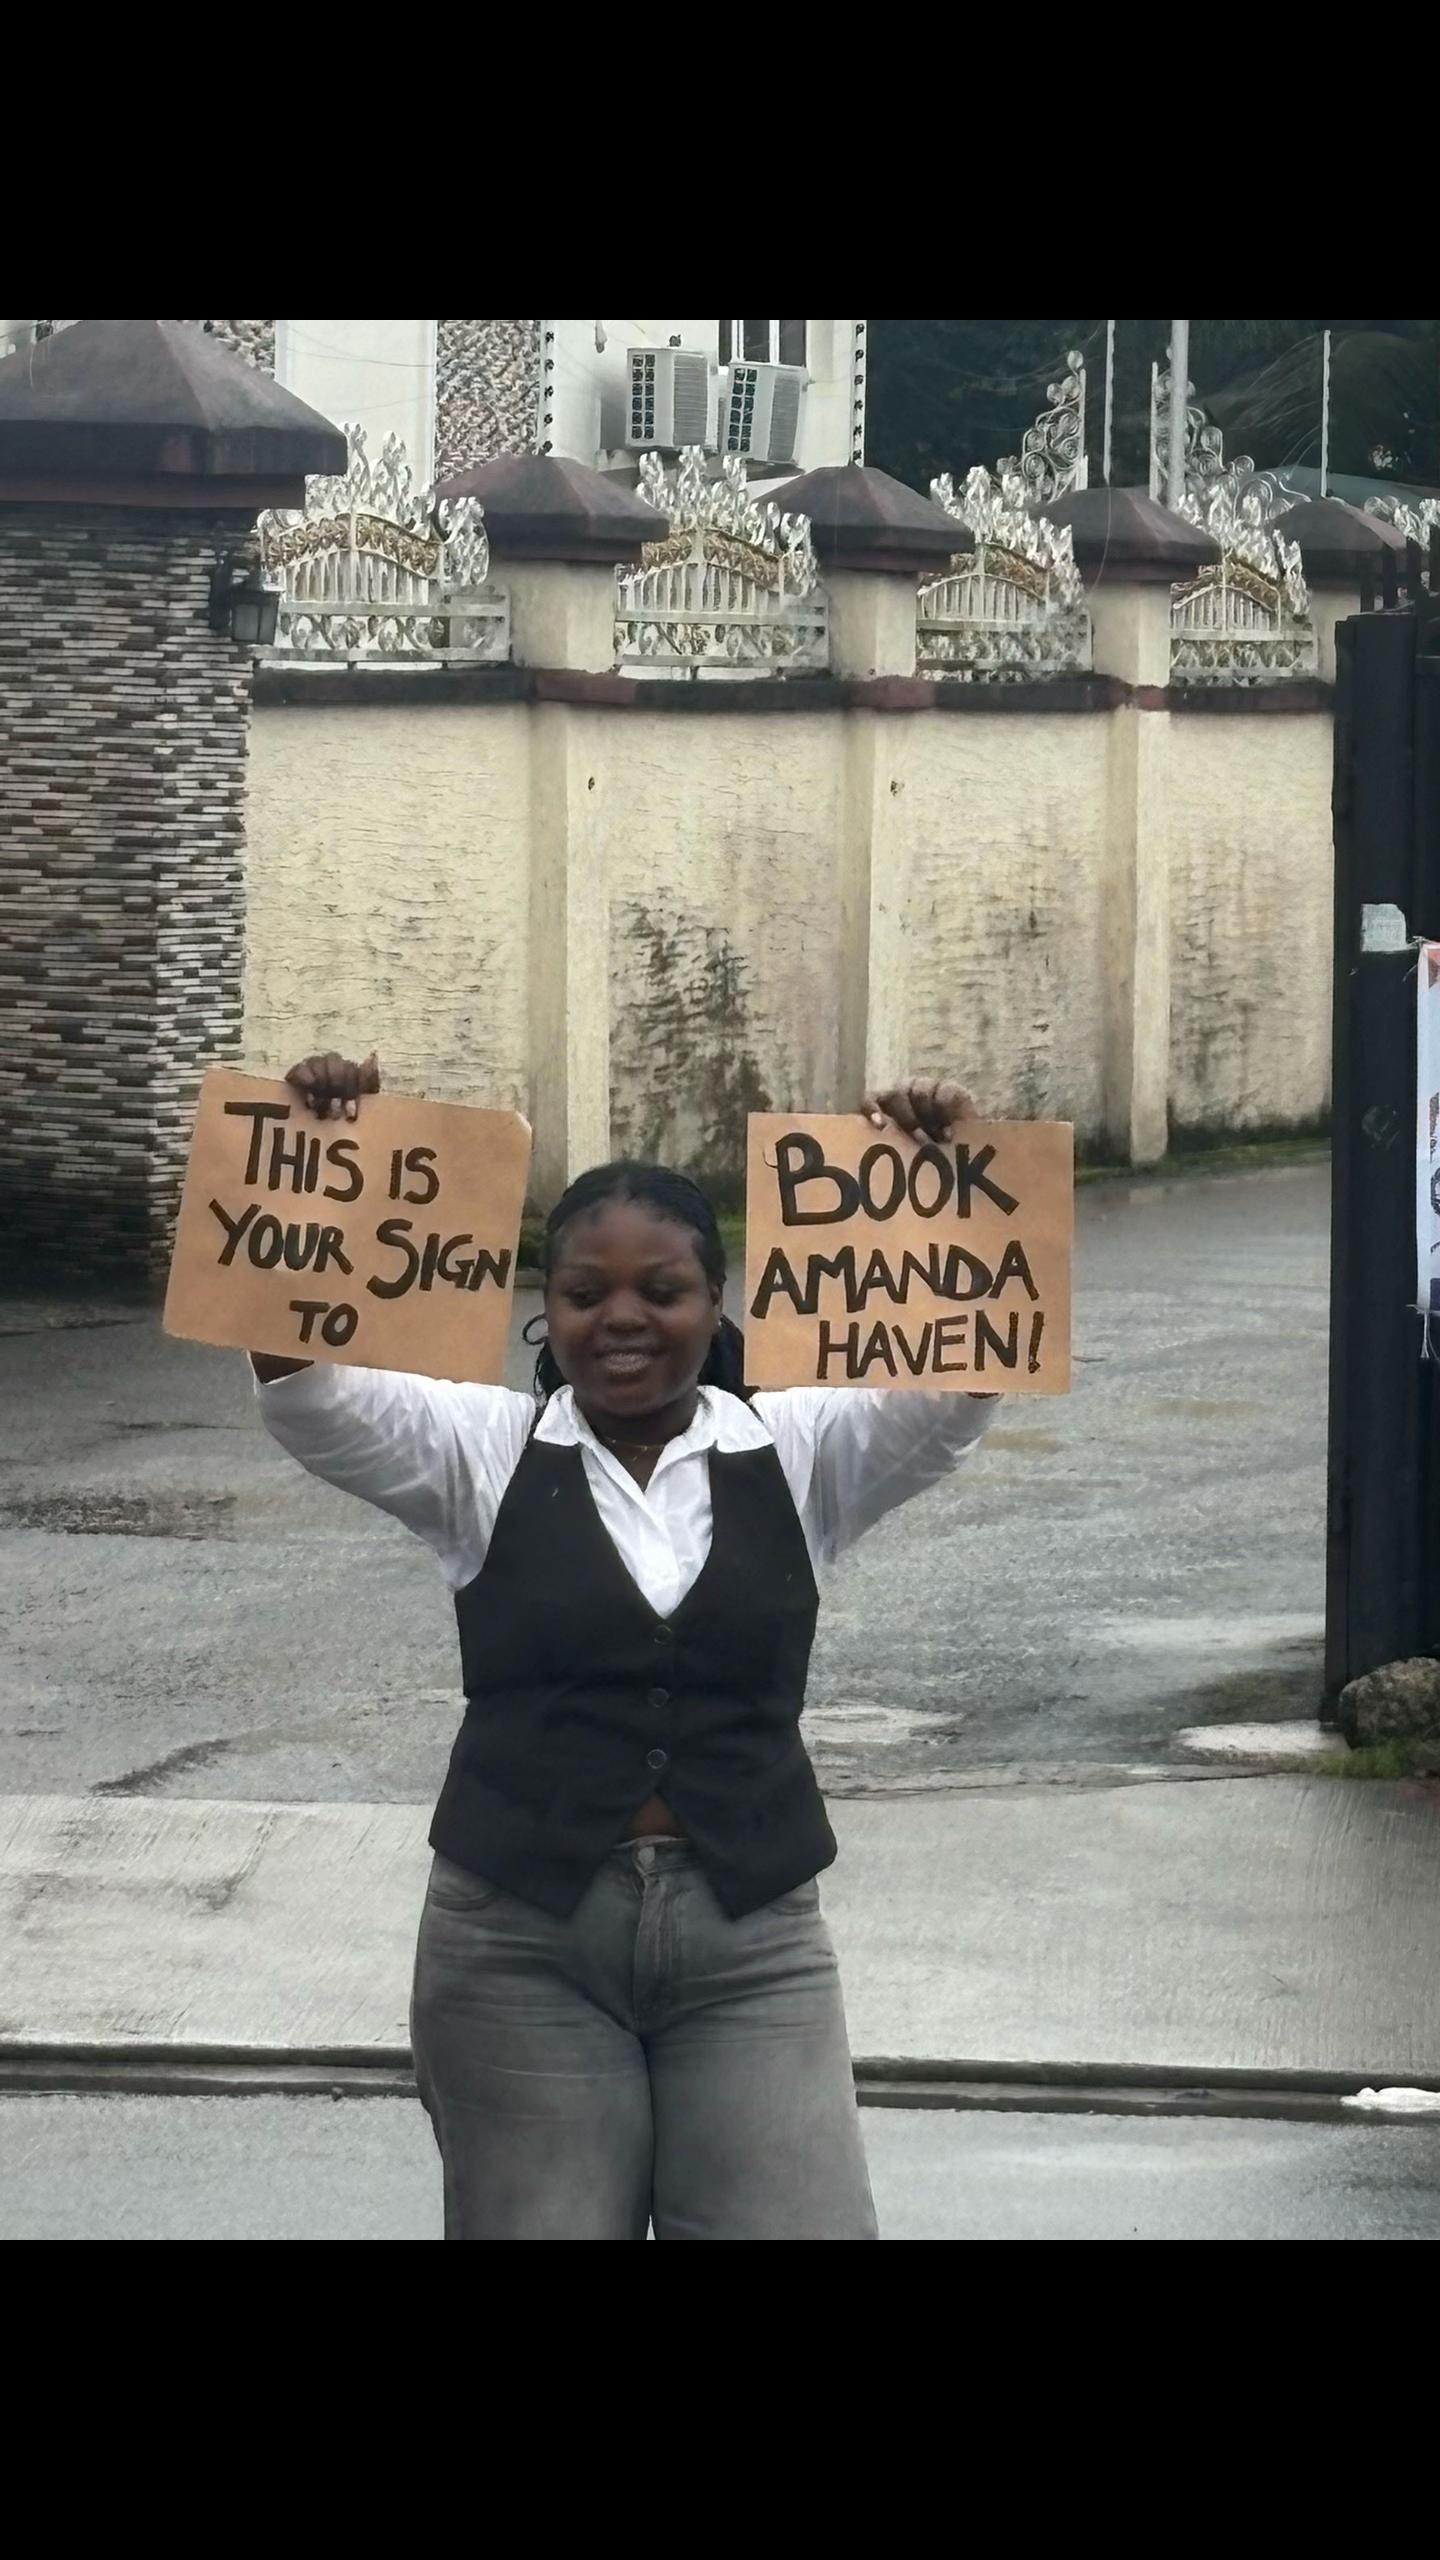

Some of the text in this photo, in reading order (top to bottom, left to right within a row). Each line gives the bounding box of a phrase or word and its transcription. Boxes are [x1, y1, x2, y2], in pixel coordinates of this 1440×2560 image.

[224, 1101, 440, 1204] THIS IS
[775, 1132, 1020, 1226] BOOK
[209, 1199, 512, 1299] YOUR SIGN
[750, 1240, 1040, 1319] AMANDA
[289, 1300, 359, 1347] TO
[816, 1310, 1045, 1379] HAVEN!
